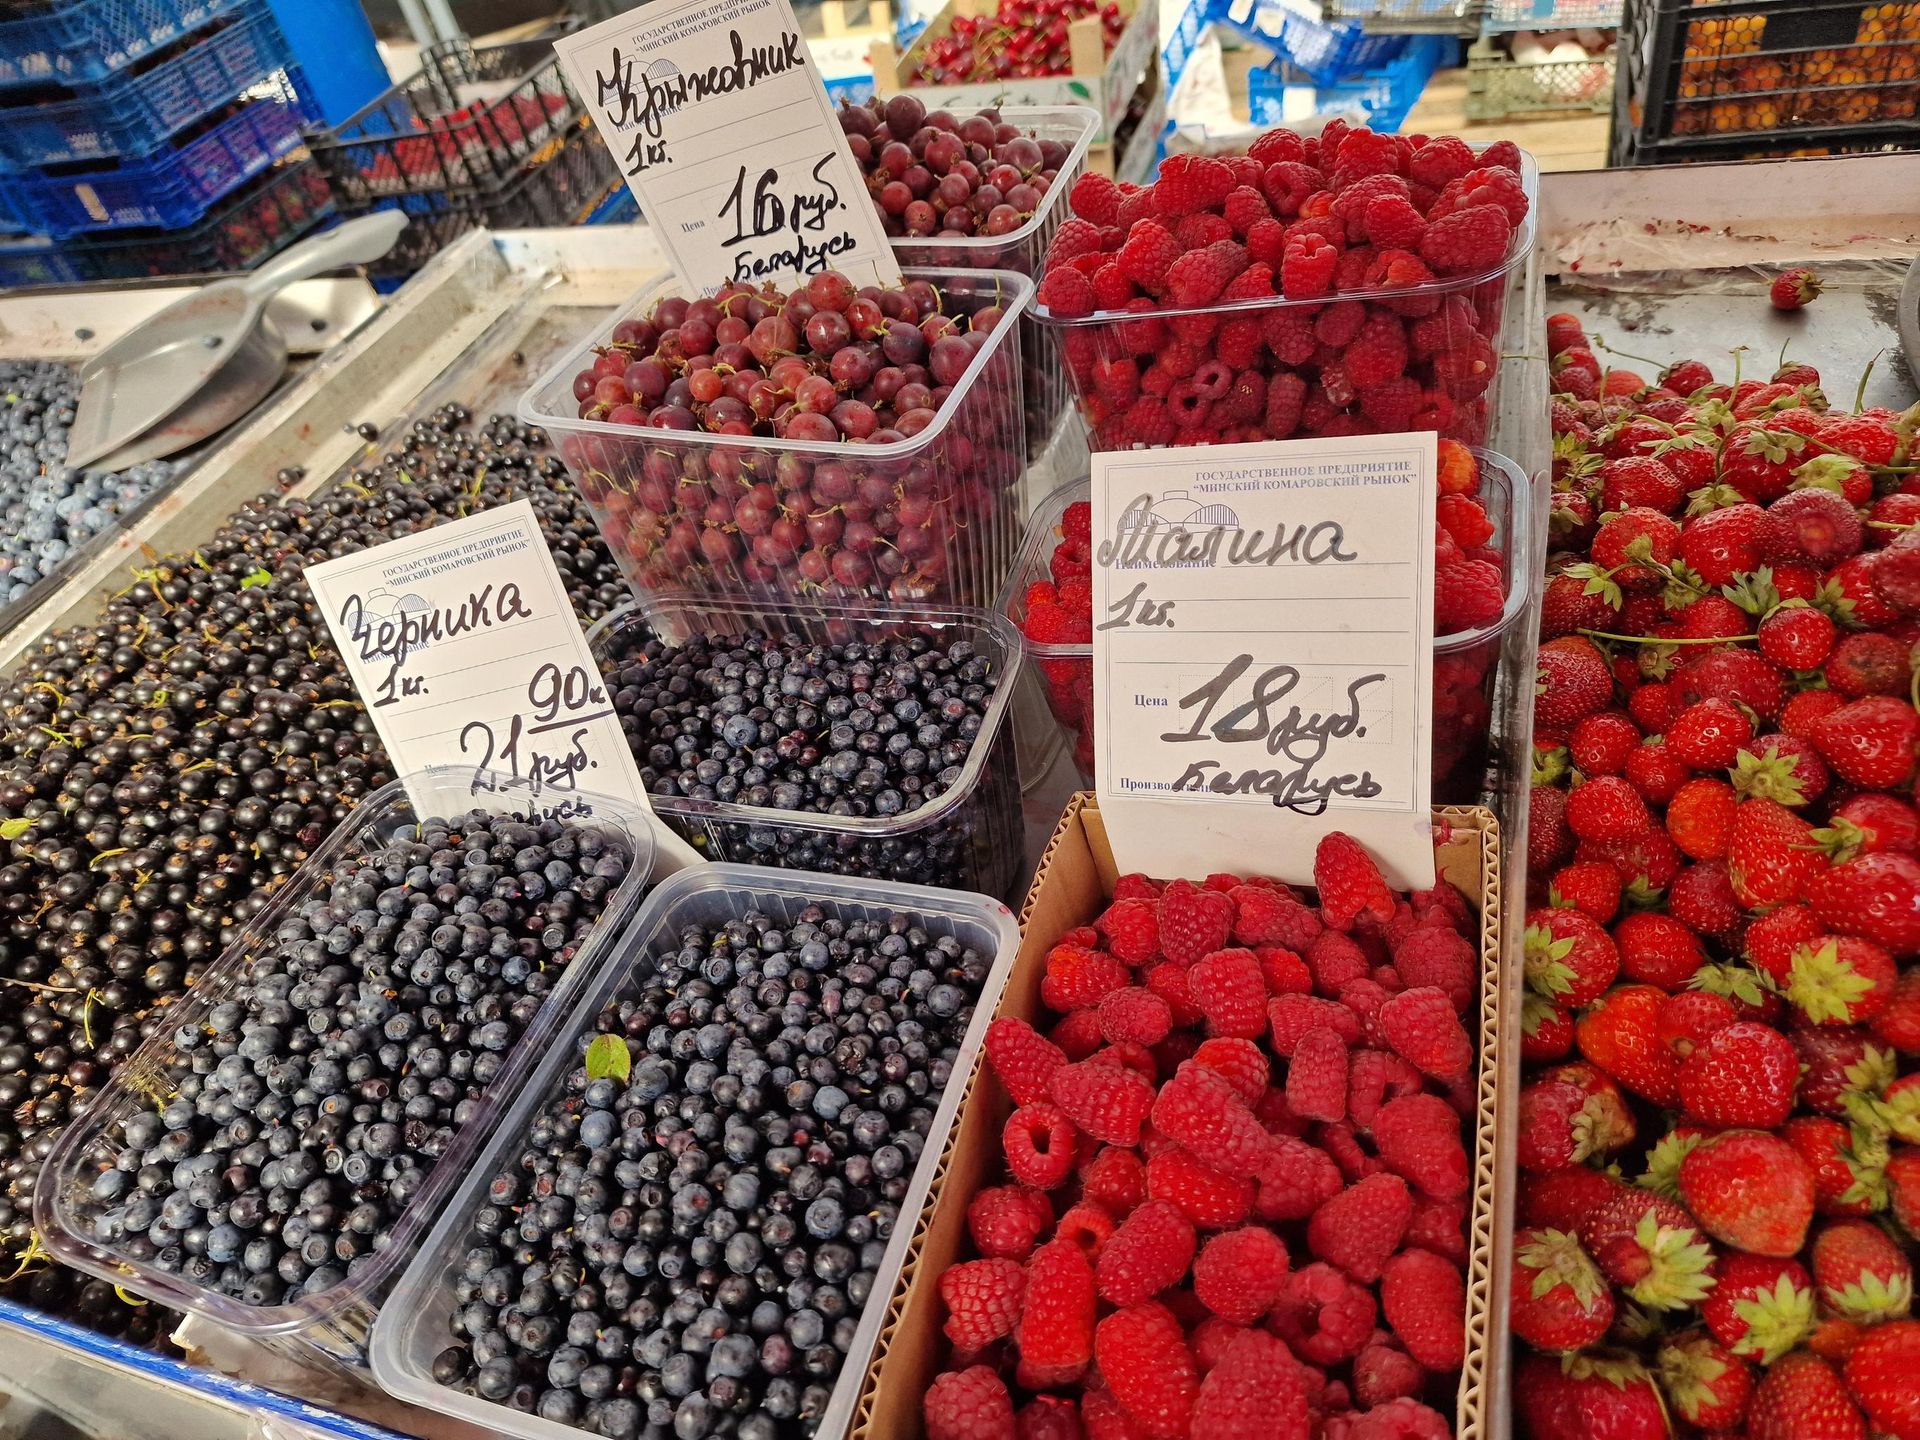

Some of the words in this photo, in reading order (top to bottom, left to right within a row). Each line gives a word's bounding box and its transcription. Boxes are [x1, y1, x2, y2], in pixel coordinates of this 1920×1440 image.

[632, 9, 708, 45] ГОСУДАРСТВЕННОЕ
[680, 8, 741, 38] КОМАРОВСКИЙ
[681, 219, 705, 233] Цена
[1195, 465, 1314, 481] ГОСУДАРСТВЕННОЕ
[1317, 461, 1412, 476] ПРЕДПРИЯТИЕ
[1263, 475, 1360, 490] КОМАРОВСКИЙ
[1096, 493, 1358, 568] Малина
[383, 547, 461, 578] ГОСУДАРСТВЕННОЕ
[461, 528, 524, 554] ПРЕДПРИЯТИЕ
[432, 549, 496, 575] КОМАРОВСКИЙ
[340, 582, 532, 666] Черника
[1134, 694, 1168, 708] Цена
